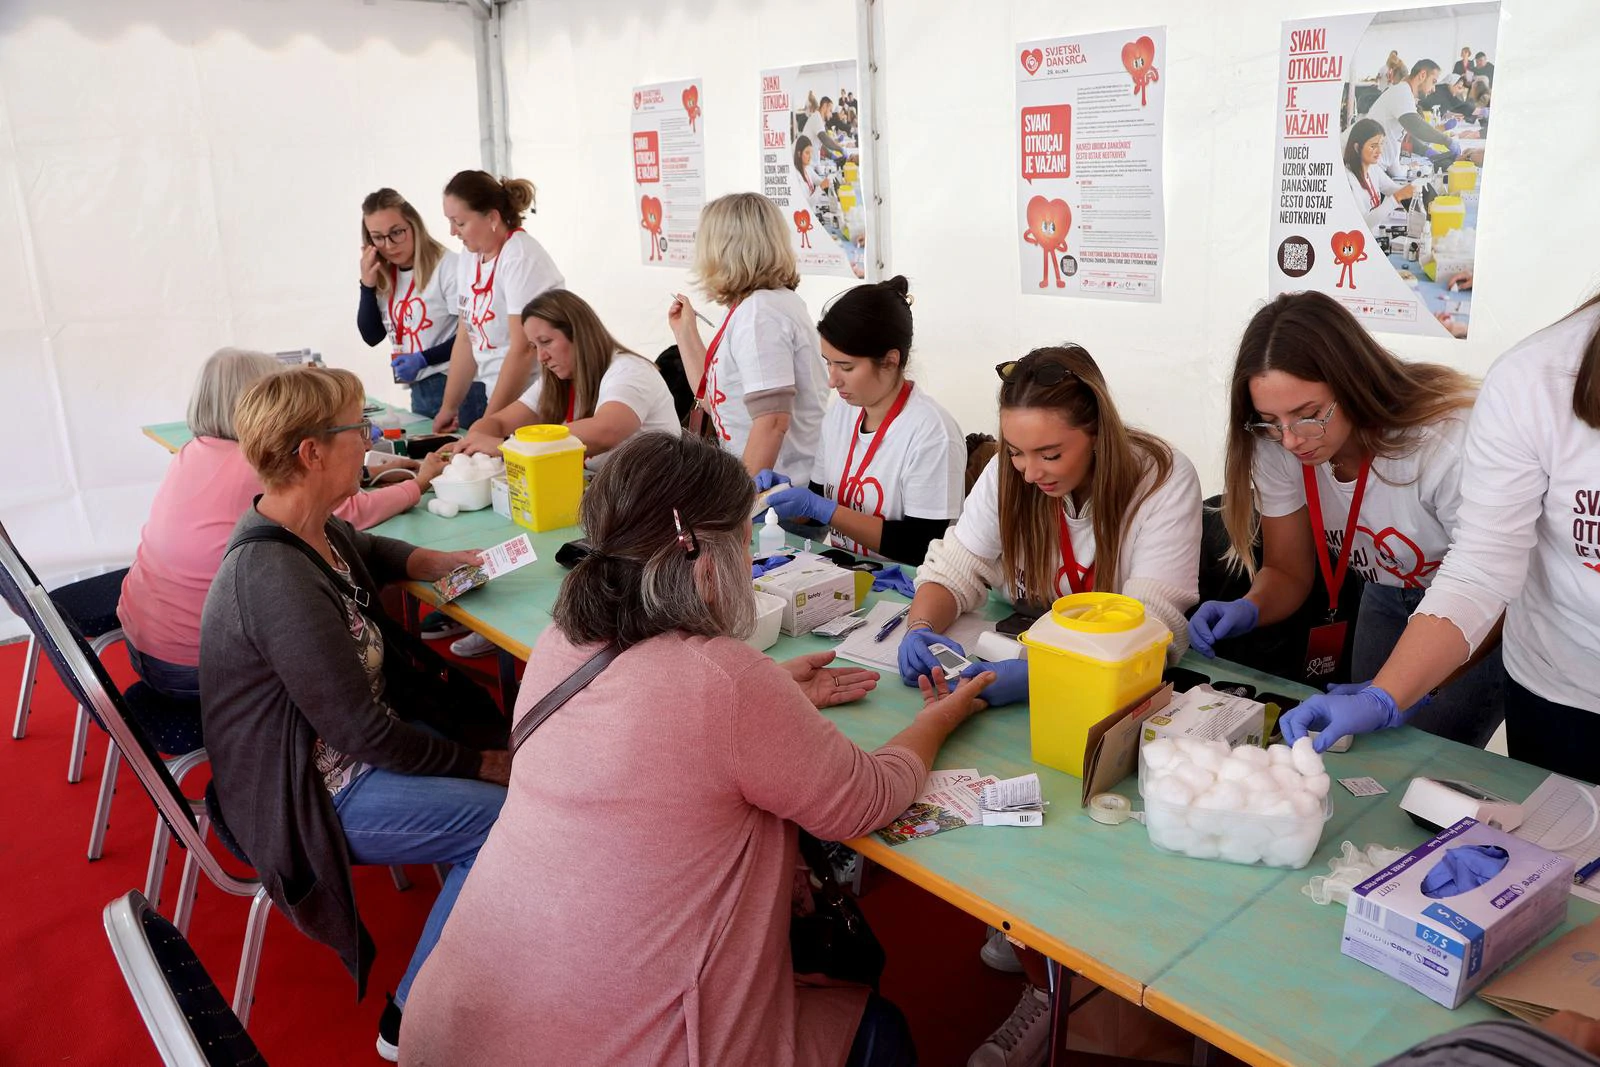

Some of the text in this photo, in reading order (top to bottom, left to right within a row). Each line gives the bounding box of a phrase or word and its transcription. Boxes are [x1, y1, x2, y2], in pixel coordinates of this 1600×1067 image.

[1290, 28, 1326, 53] SVAKI
[1045, 44, 1081, 57] SVJETSKI
[1046, 54, 1087, 67] DAN SRCA
[1288, 55, 1343, 80] OTKUCAJ
[763, 76, 780, 91] SVAKI
[763, 93, 788, 110] OTKUCAJ
[1286, 87, 1298, 108] JE
[1025, 113, 1051, 132] SVAKI
[1285, 109, 1329, 135] VAŽAN!
[1025, 134, 1063, 153] OTKUCAJ
[1283, 143, 1309, 160] VODEĆI
[1025, 156, 1034, 174] JE
[1035, 151, 1066, 173] VAŽAN!
[1282, 163, 1333, 176] UZROK SMRTI
[1282, 177, 1327, 192] DANAŠNJICE
[1280, 192, 1333, 209] ČESTO OSTAJE
[1280, 211, 1326, 225] NEOTKRIVEN
[1573, 489, 1600, 516] SV
[1324, 529, 1345, 547] AKI
[1573, 518, 1600, 545] OT
[1422, 929, 1448, 948] 6-7 S
